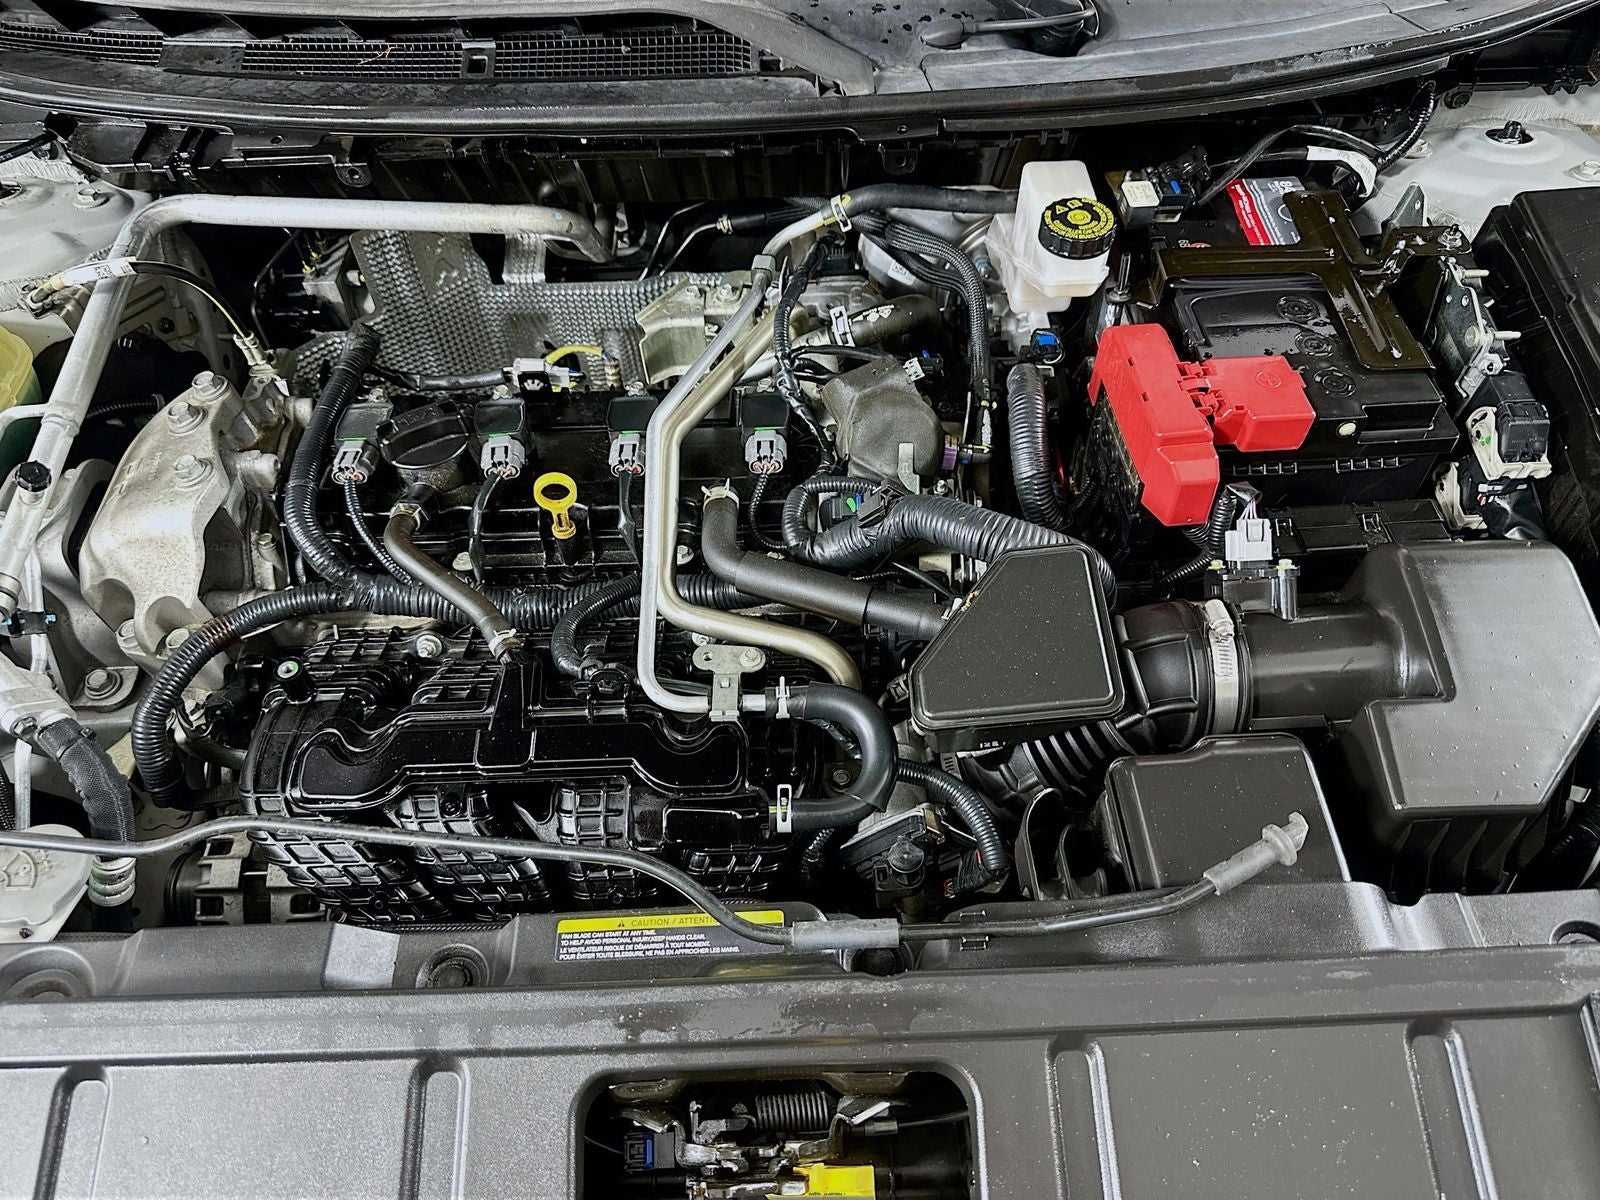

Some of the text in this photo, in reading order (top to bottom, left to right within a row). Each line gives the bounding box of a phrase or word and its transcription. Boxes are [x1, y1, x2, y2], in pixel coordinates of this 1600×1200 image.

[678, 917, 715, 925] ATTENTI
[568, 945, 604, 953] VENTILATEUR
[634, 942, 664, 950] DÉMARRER
[576, 952, 595, 960] ÉVITER
[674, 947, 709, 955] APPROCHER
[720, 945, 740, 953] MAINS.
